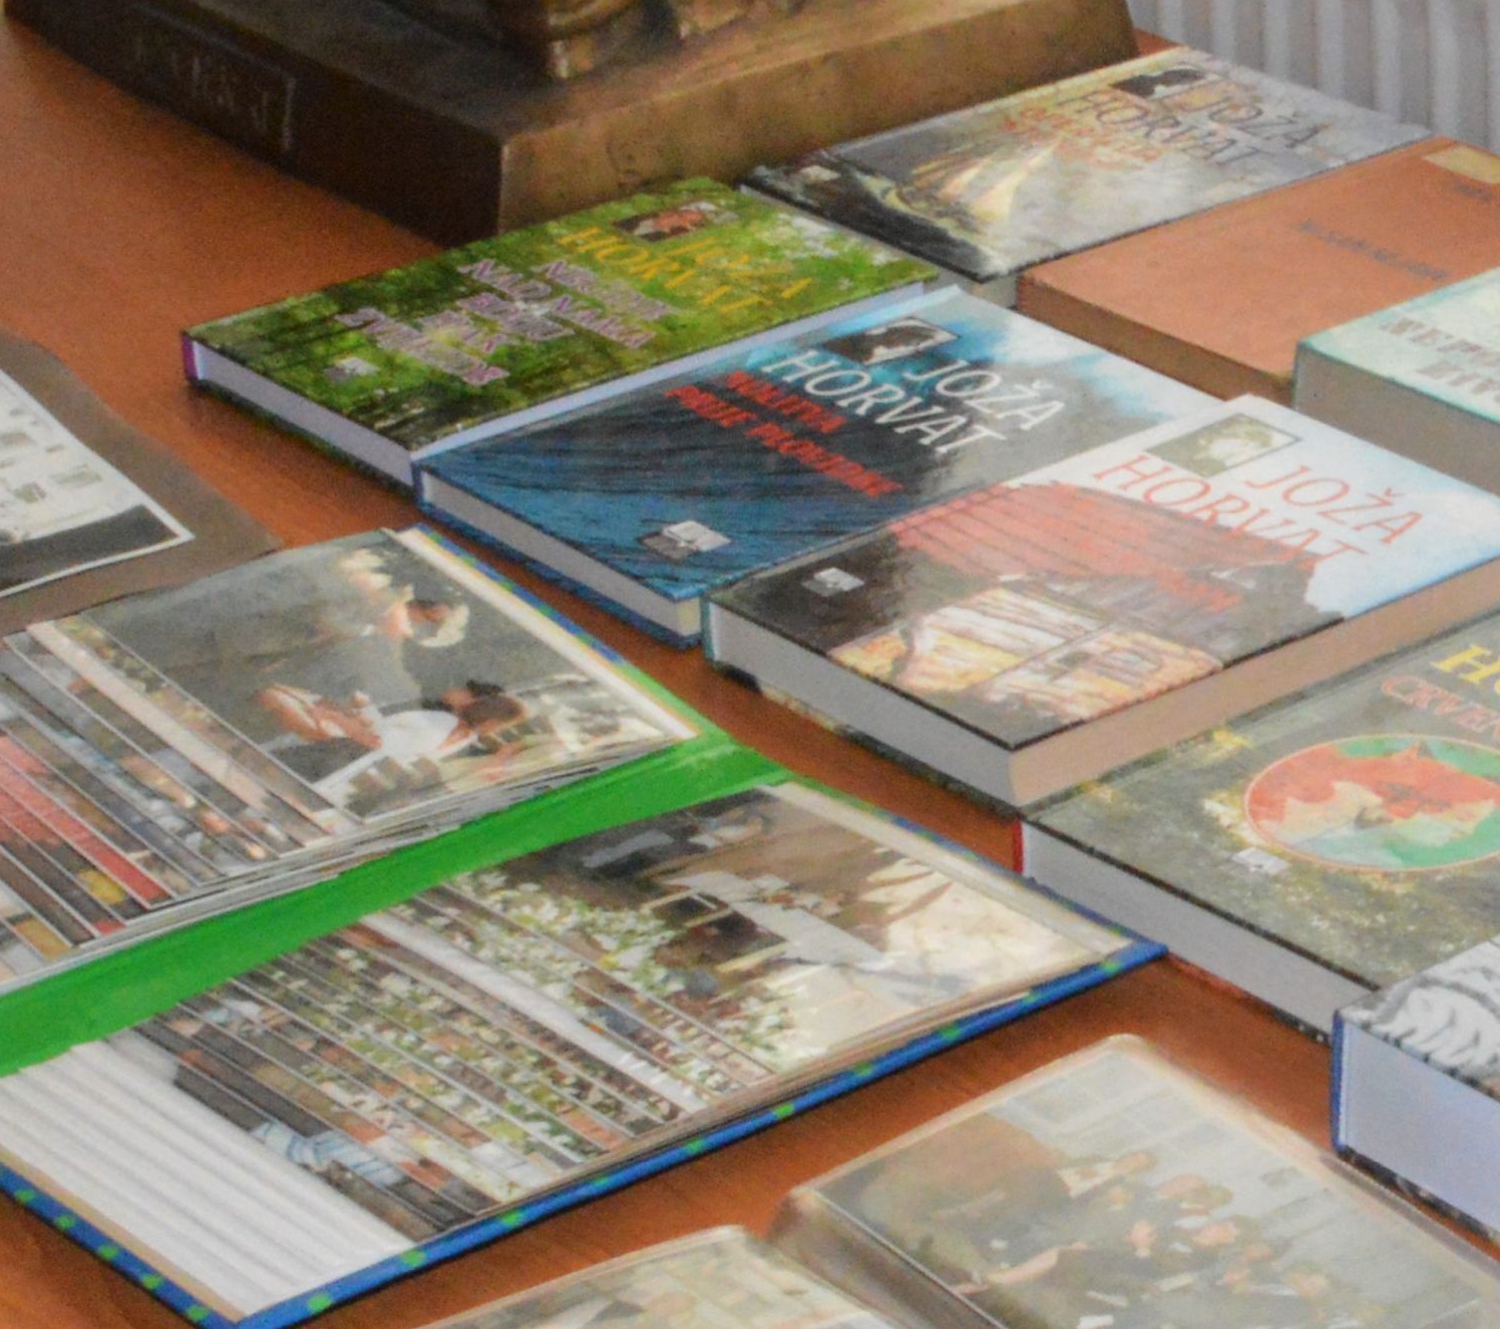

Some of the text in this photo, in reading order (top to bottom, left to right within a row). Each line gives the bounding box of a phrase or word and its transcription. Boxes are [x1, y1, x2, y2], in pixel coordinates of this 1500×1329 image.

[1058, 89, 1270, 166] HORVAT
[761, 349, 1007, 455] HORVAT
[903, 357, 1064, 432] JOŽA
[1092, 453, 1371, 573] HORVAT
[1243, 462, 1425, 547] JOŽA
